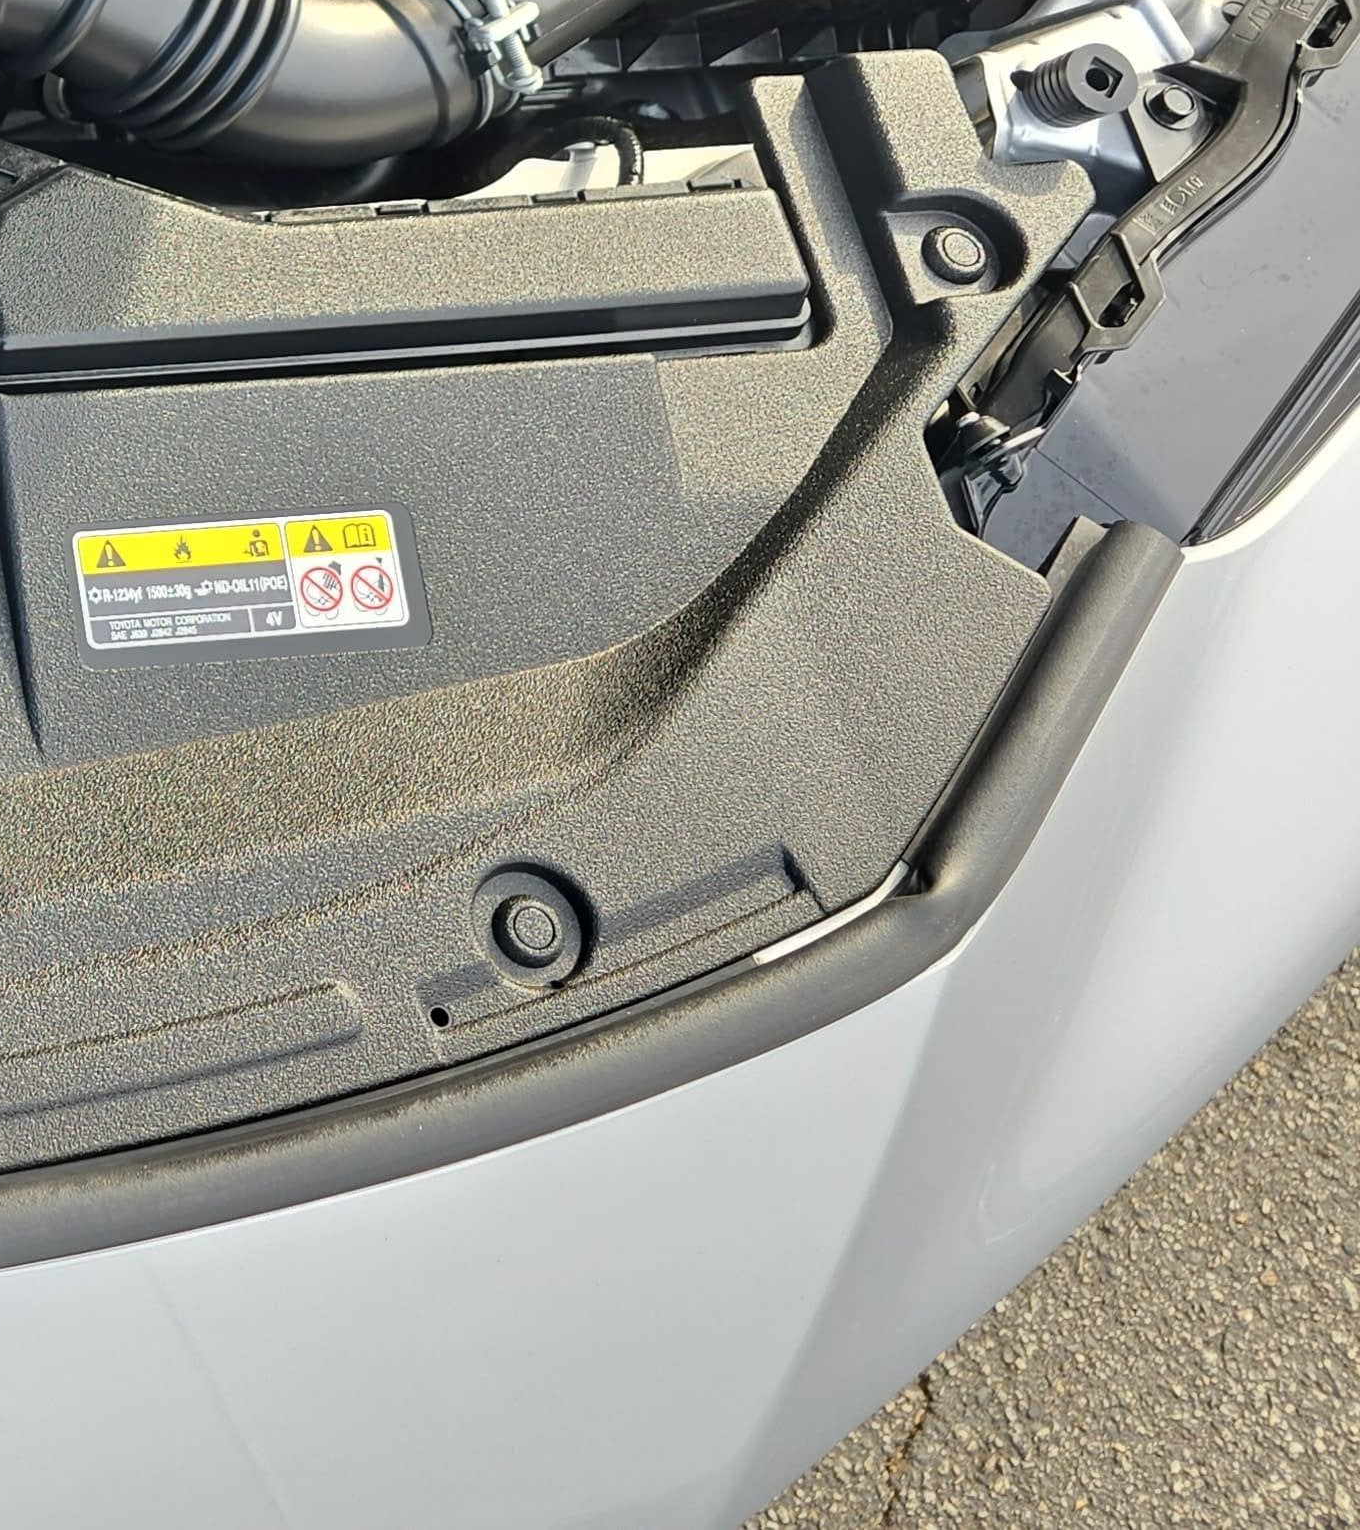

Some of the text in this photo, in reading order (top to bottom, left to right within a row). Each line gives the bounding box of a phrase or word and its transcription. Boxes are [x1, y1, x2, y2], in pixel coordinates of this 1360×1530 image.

[108, 610, 283, 631] TOYOTA MOTOR CORPORATION 4V
[110, 630, 128, 641] SAE
